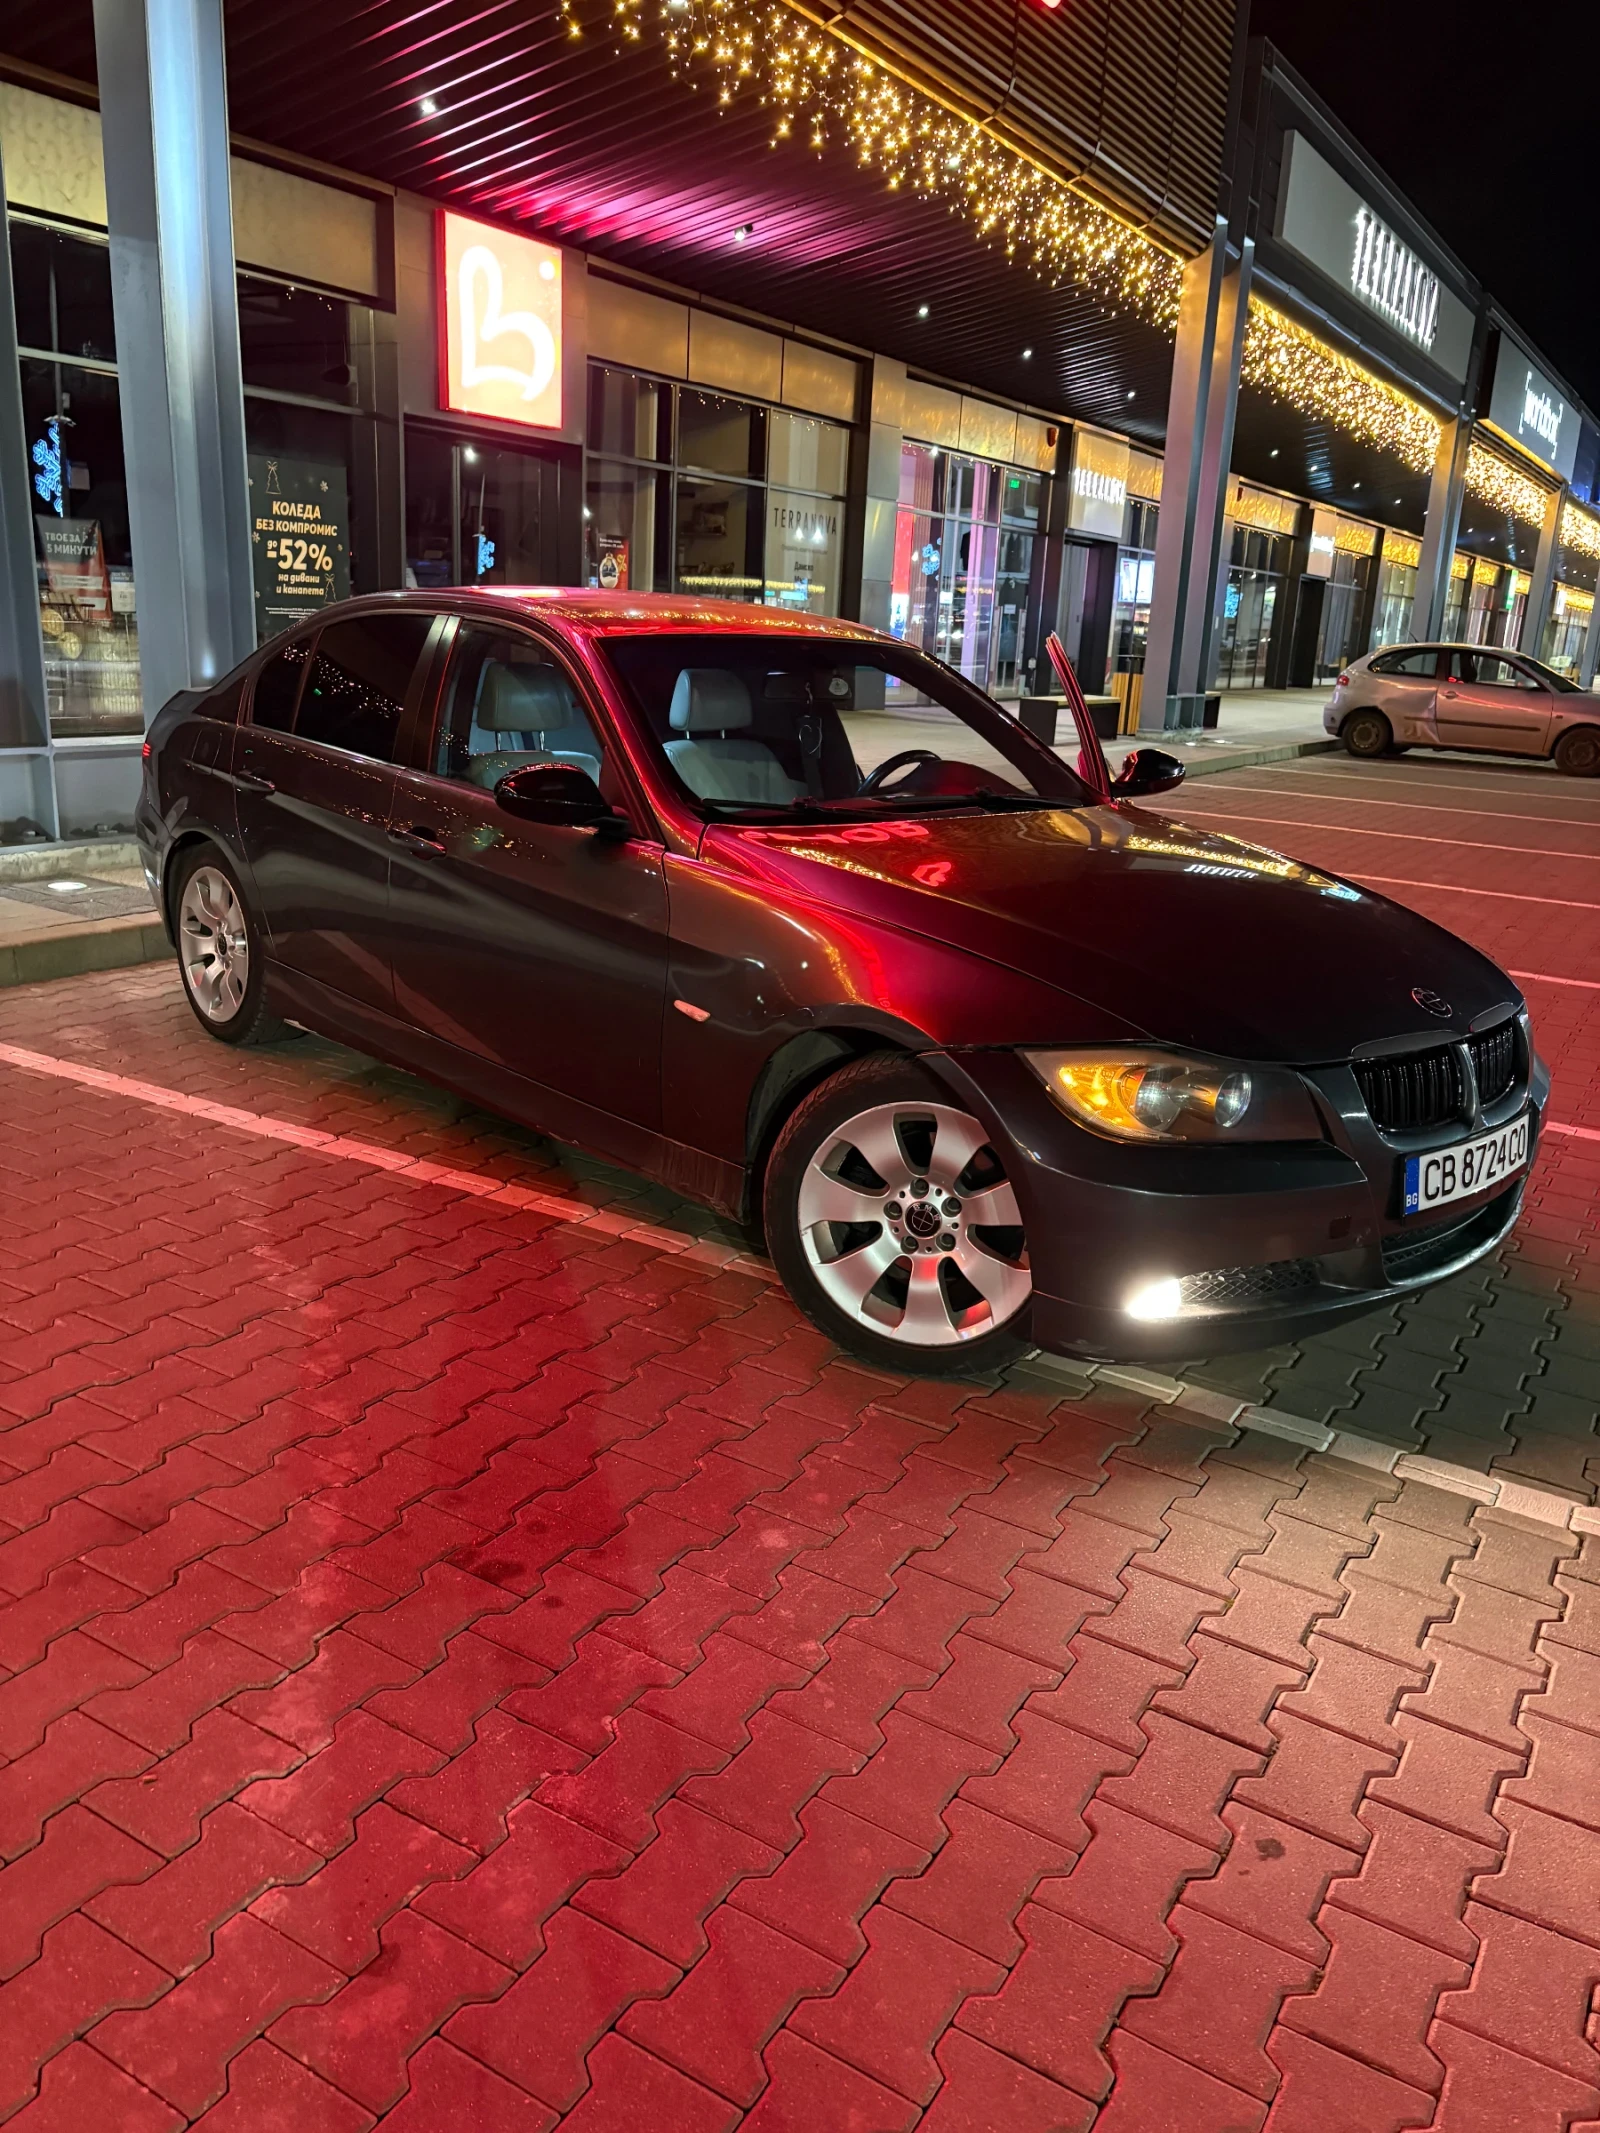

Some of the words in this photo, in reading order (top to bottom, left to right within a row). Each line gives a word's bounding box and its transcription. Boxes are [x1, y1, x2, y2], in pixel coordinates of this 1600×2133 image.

[272, 501, 321, 520] КОЛЕДА
[256, 518, 274, 530] БЕЗ
[275, 520, 338, 536] КОМПРОМИС
[774, 508, 837, 535] TERRANOVA
[44, 532, 69, 542] ТВОЕ
[69, 534, 80, 543] ЗА
[47, 544, 53, 553] 5
[54, 545, 97, 555] МИНУТИ
[278, 573, 289, 582] на
[290, 572, 320, 584] дивани
[276, 585, 282, 594] и
[283, 584, 324, 595] канапета
[1424, 1154, 1457, 1201] CB
[1461, 1133, 1507, 1189] 8724
[1508, 1123, 1526, 1166] CO
[1406, 1193, 1418, 1207] BG
